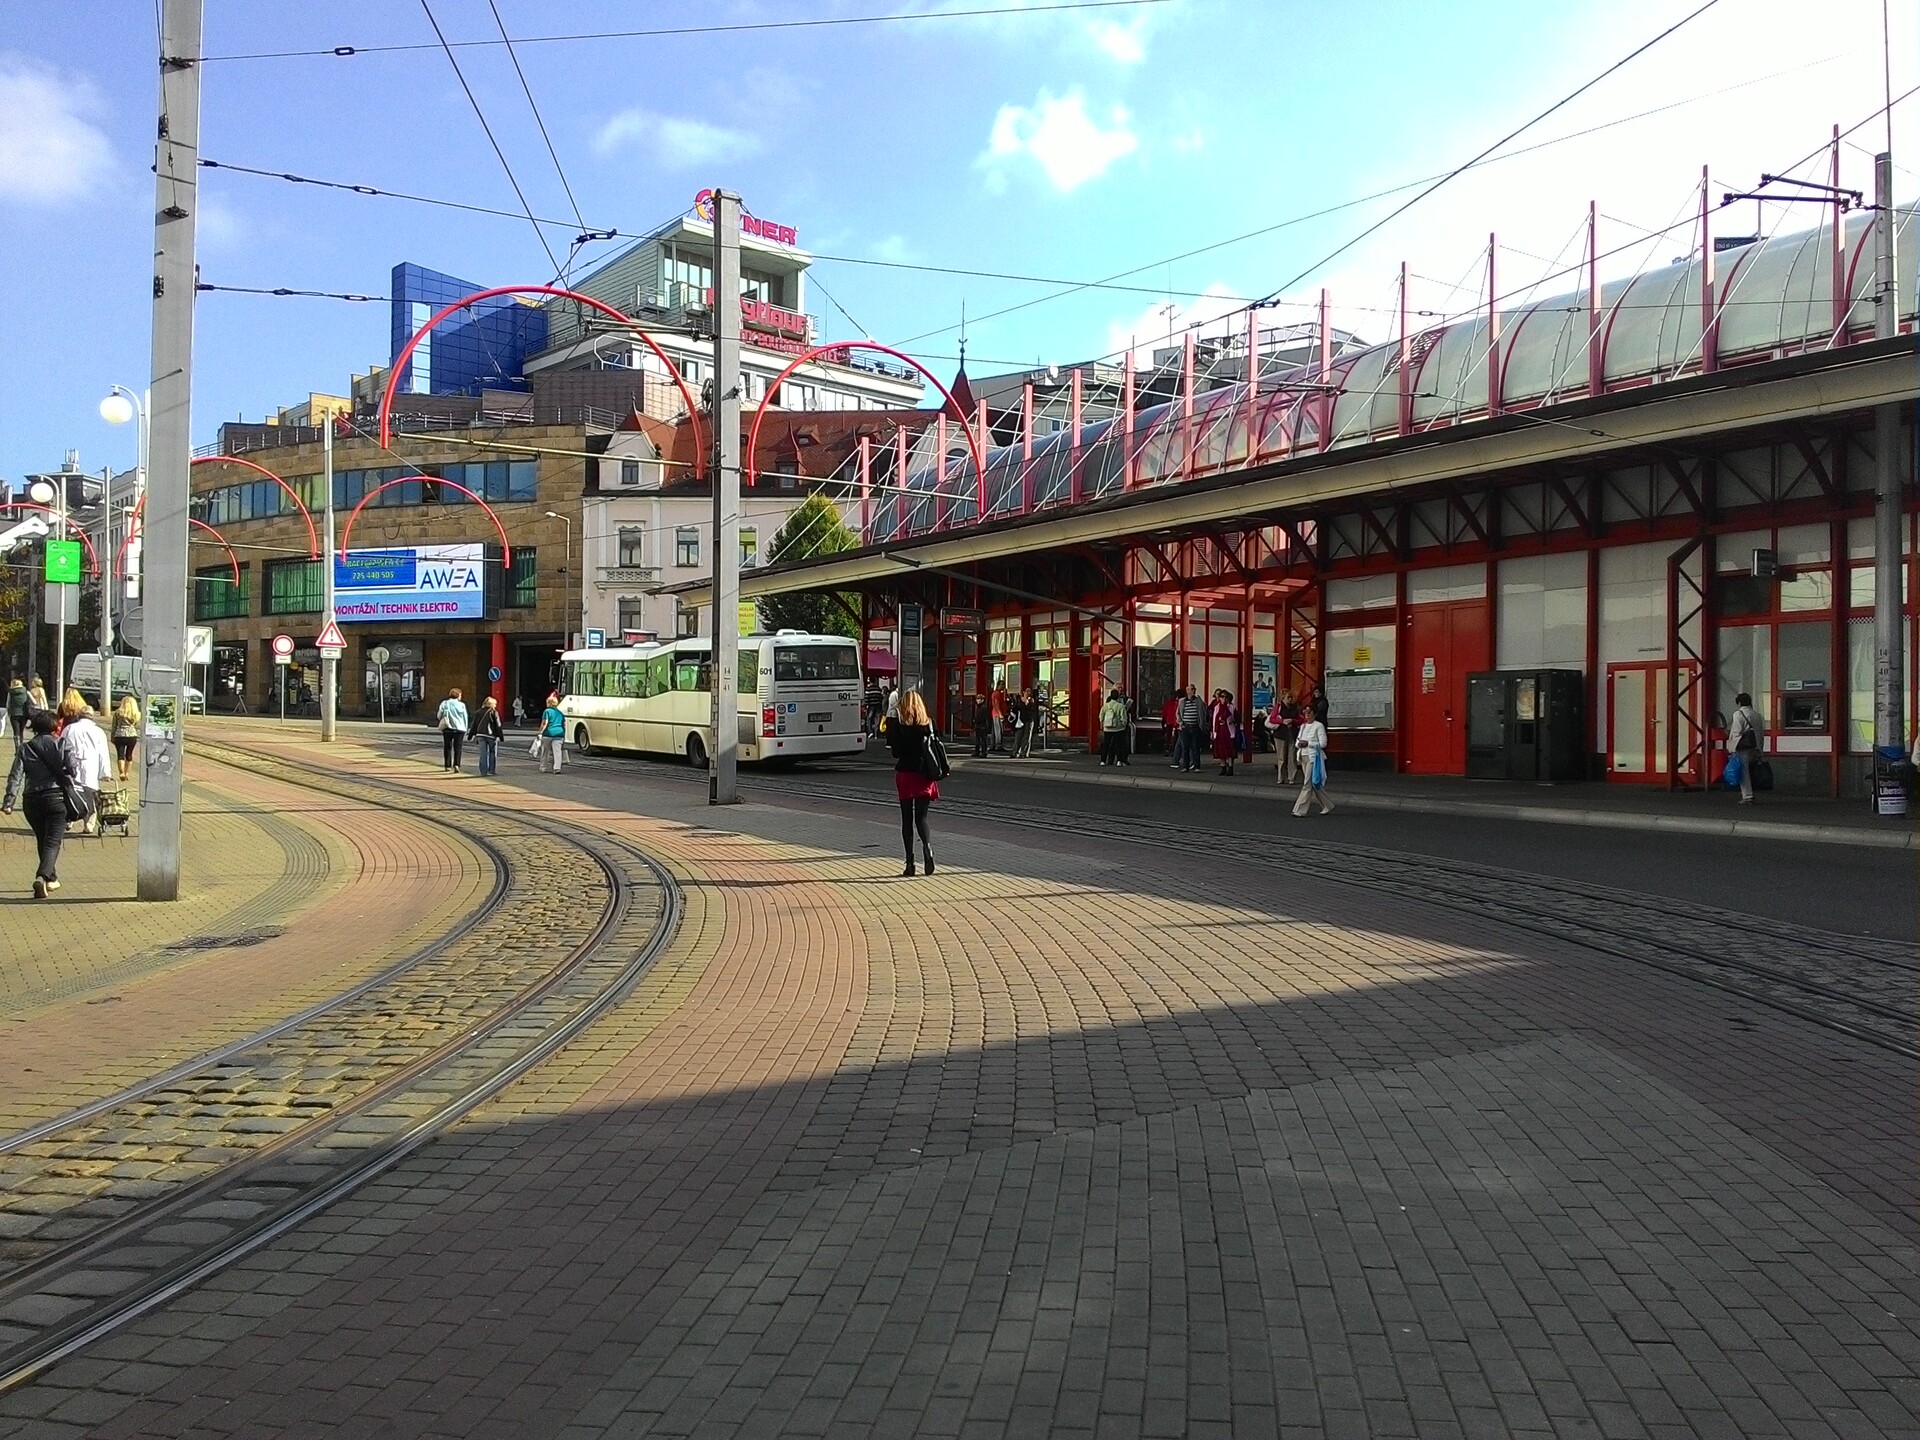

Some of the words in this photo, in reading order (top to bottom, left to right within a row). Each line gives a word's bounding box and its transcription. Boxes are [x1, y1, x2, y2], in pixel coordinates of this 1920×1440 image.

[420, 568, 478, 590] AWEA
[335, 602, 379, 615] MONTÁŽNÍ
[420, 602, 458, 613] ELEKTRO
[759, 667, 773, 676] 601
[837, 692, 851, 700] 601
